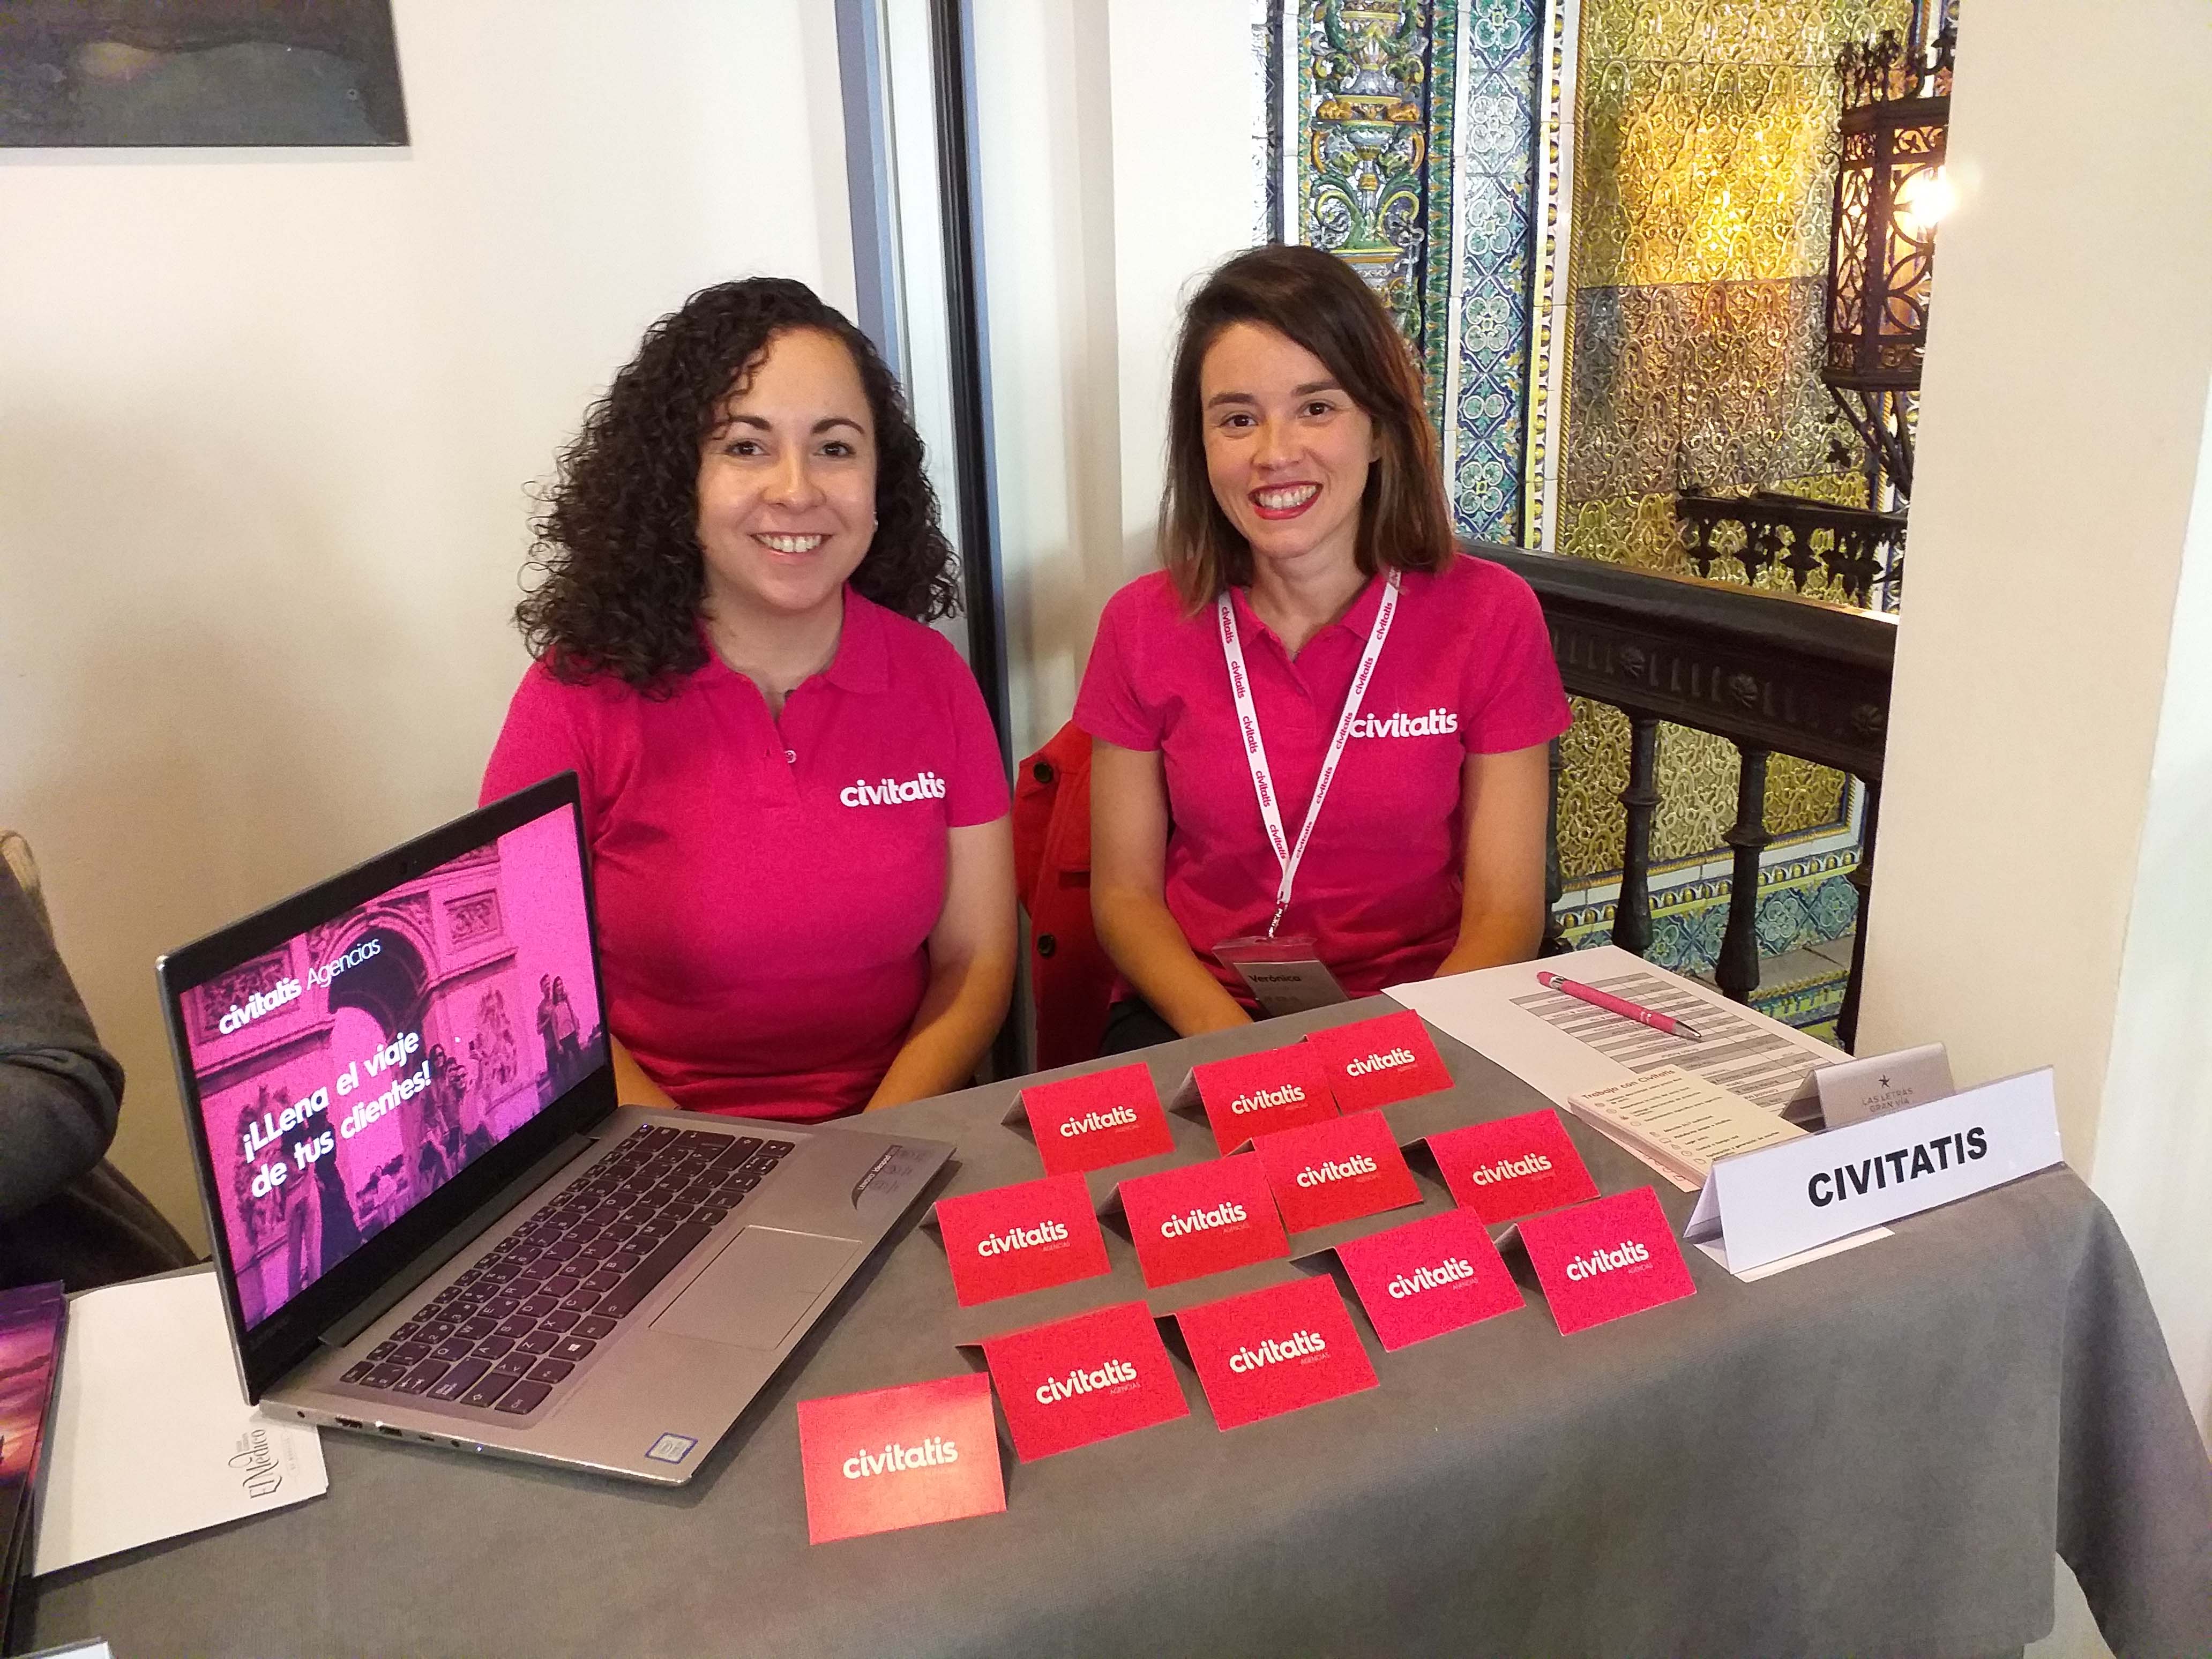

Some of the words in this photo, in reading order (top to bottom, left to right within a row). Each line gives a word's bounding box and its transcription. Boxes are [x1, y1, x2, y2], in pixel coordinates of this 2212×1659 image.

[1222, 607, 1234, 644] civitatis
[1377, 601, 1393, 640] civitatis
[1231, 661, 1245, 699] civitatis
[1355, 656, 1374, 695] civitatis
[1243, 716, 1257, 754] civitatis
[1336, 712, 1353, 750] civitatis
[1350, 707, 1458, 738] civitatis
[840, 771, 946, 807] civitatis
[1256, 771, 1271, 807] civitatis
[1317, 767, 1332, 804] civitatis
[1270, 824, 1287, 860] civitatis
[219, 977, 302, 1035] civitatis
[306, 938, 381, 990] Agencias
[336, 1061, 359, 1096] el
[364, 1032, 419, 1078] viaje
[1346, 1047, 1416, 1077] civitatis
[1231, 1083, 1305, 1115] civitatis
[1582, 1087, 1619, 1099] Trabaja
[1862, 1095, 1879, 1105] LAS
[1881, 1087, 1914, 1101] LETRAS
[251, 1162, 288, 1198] de
[294, 1130, 334, 1170] tus
[341, 1060, 431, 1139] clientes!
[1060, 1105, 1137, 1138] civitatis
[1296, 1154, 1378, 1187] civitatis
[1472, 1152, 1552, 1186] civitatis
[1808, 1126, 1987, 1207] CIVITATIS
[1161, 1201, 1247, 1238] civitatis
[977, 1220, 1068, 1257] civitatis
[1388, 1257, 1474, 1298] civitatis
[1566, 1240, 1649, 1281] civitatis
[1229, 1330, 1326, 1373] civitatis
[1035, 1358, 1138, 1404] civitatis
[843, 1436, 958, 1479] civitatis
